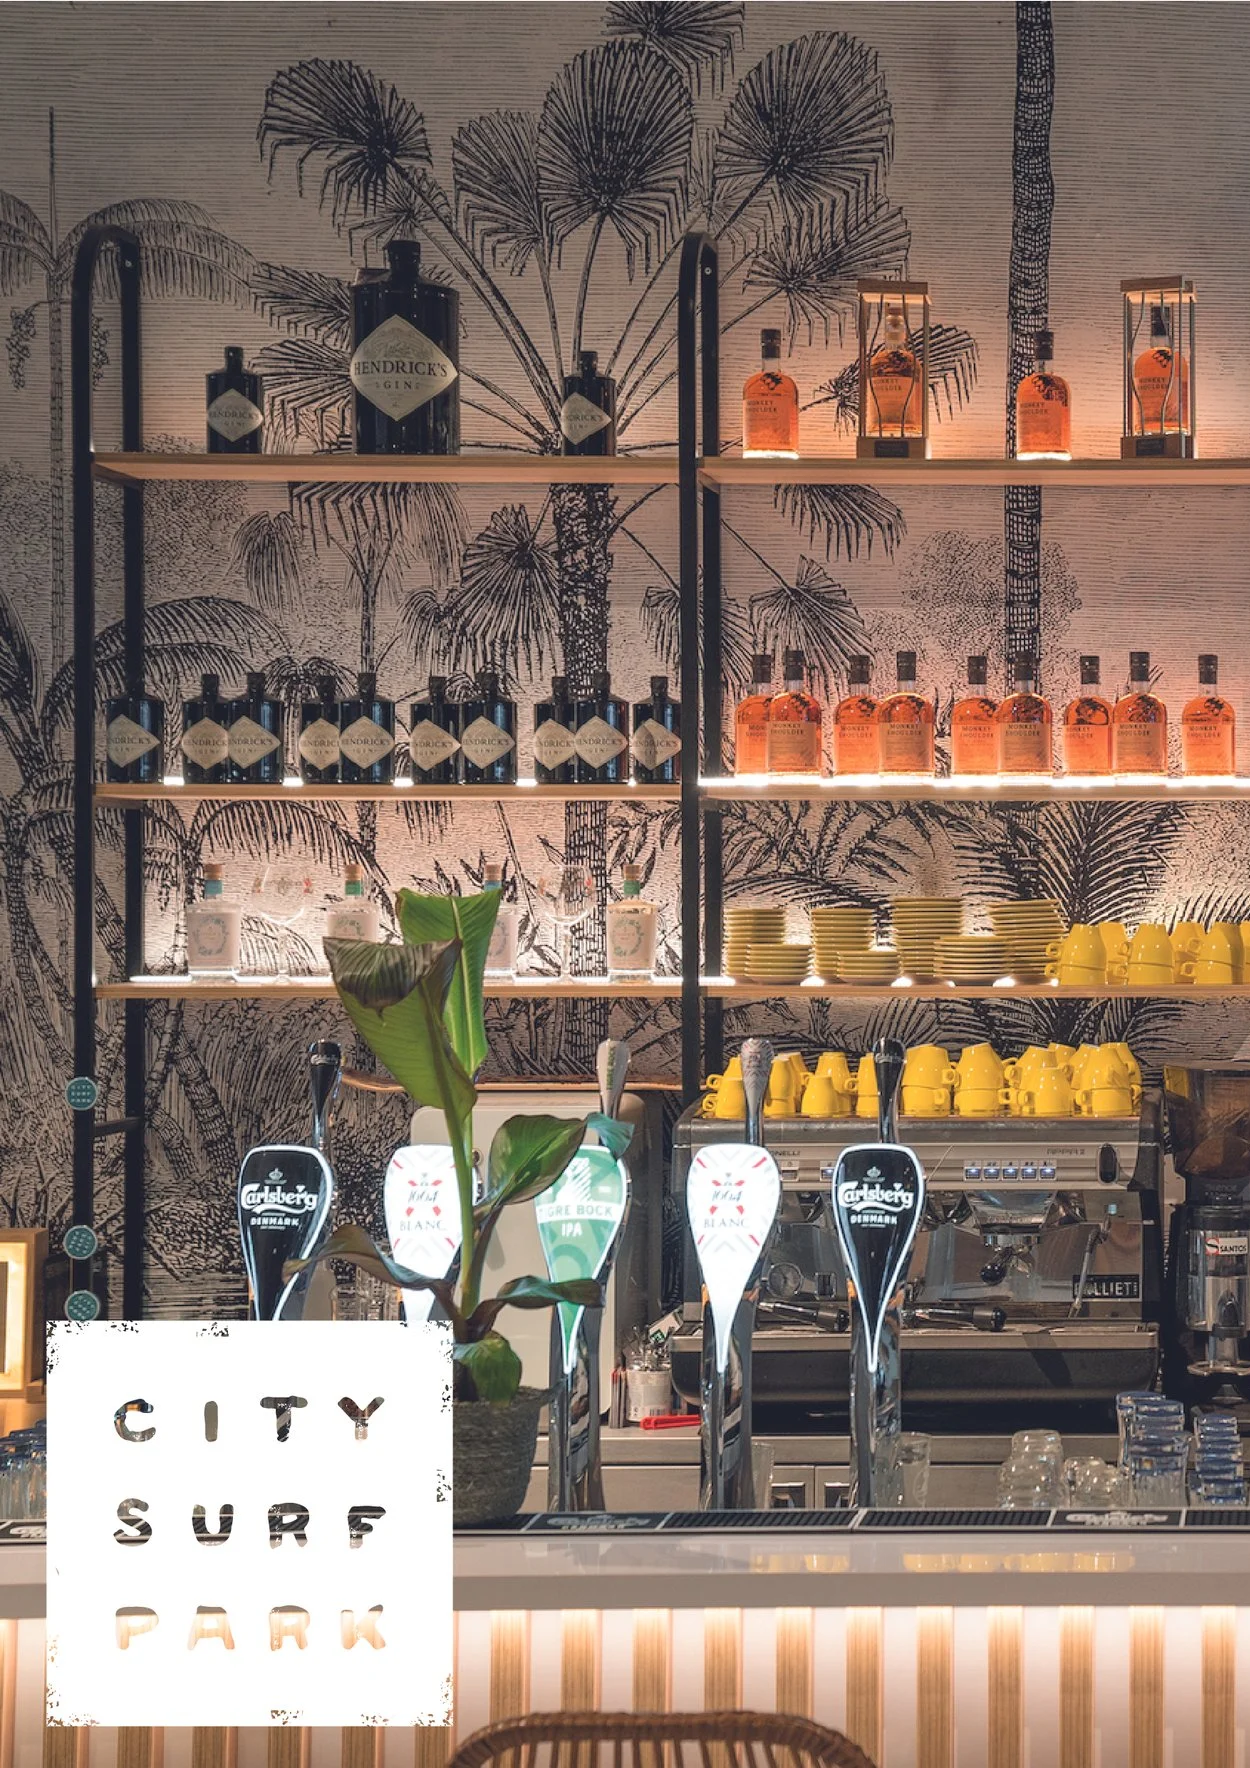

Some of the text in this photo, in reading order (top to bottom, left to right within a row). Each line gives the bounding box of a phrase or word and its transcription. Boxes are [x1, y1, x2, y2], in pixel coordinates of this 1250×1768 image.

[354, 360, 448, 377] HENDRICK'S
[383, 380, 411, 389] GIN
[241, 1183, 318, 1214] Carlsberg
[838, 1181, 914, 1212] Carlsberg
[576, 1204, 613, 1217] BOCK
[250, 1217, 300, 1226] DENMARK
[704, 1218, 750, 1229] BLANC
[850, 1214, 898, 1225] DENMARK
[400, 1220, 447, 1231] BLANC
[561, 1221, 583, 1237] IPA
[1220, 1244, 1247, 1253] SANTOS
